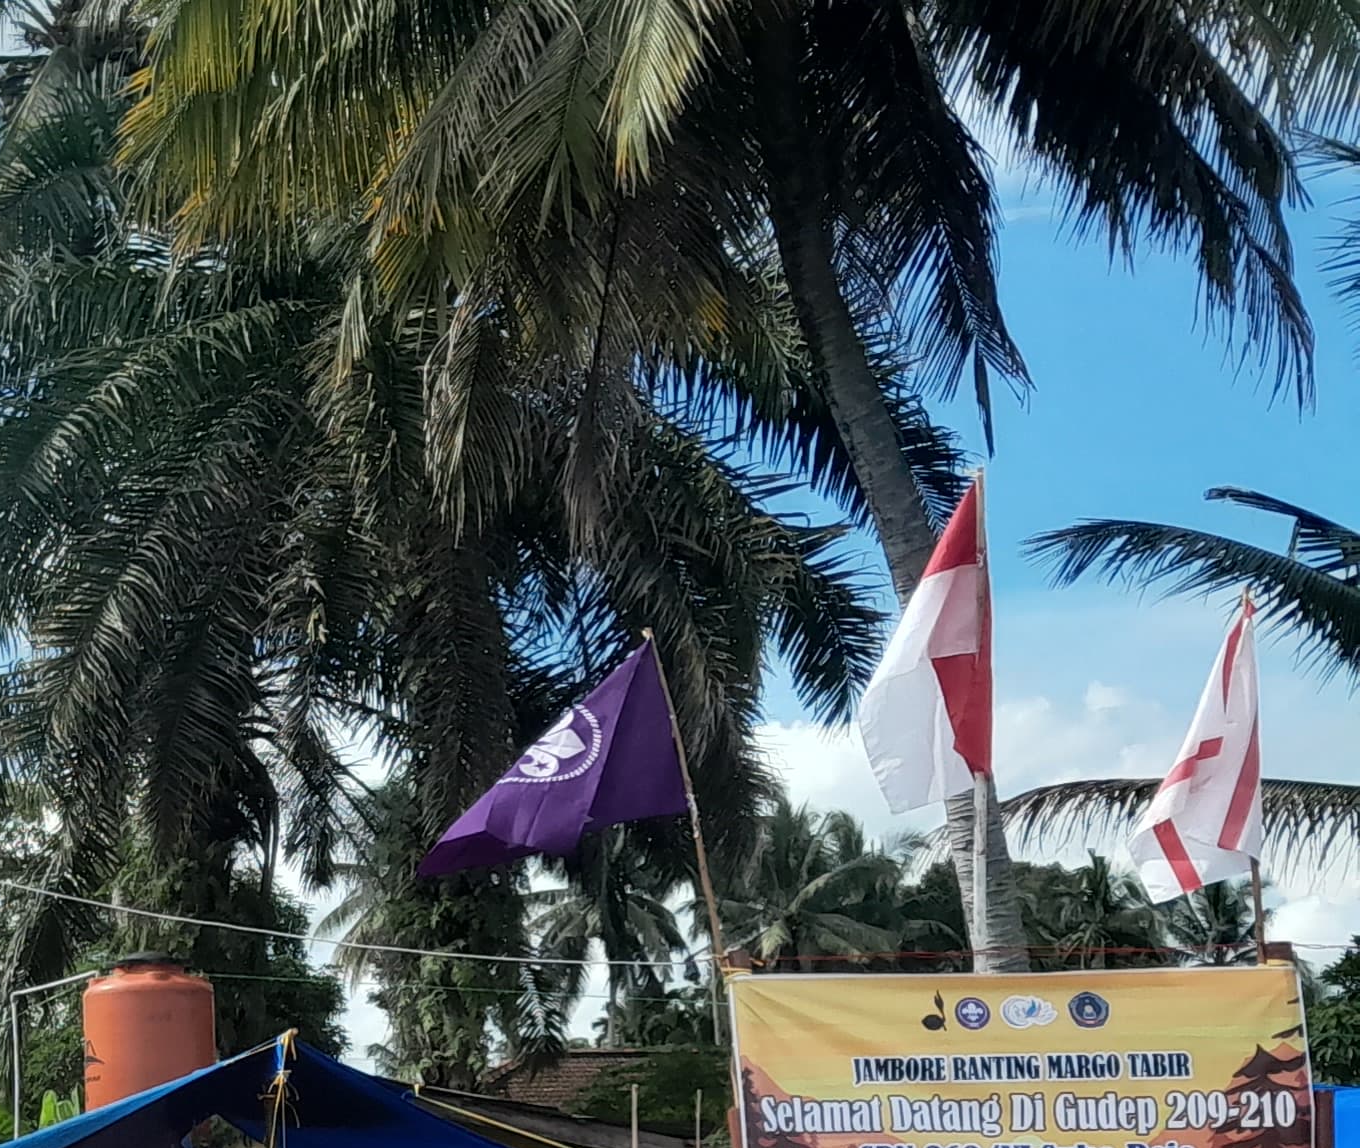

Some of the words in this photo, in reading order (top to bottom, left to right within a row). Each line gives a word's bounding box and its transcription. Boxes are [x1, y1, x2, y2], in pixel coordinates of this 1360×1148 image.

[853, 1057, 947, 1086] JAMBORE
[953, 1054, 1041, 1082] RANTING
[1047, 1053, 1121, 1080] MARGO
[1127, 1052, 1191, 1078] TABIR
[760, 1094, 885, 1134] Selamat
[888, 1093, 1003, 1137] Datang
[1010, 1092, 1046, 1133] Di
[1054, 1089, 1159, 1135] Gudep
[1166, 1089, 1297, 1130] 209-210
